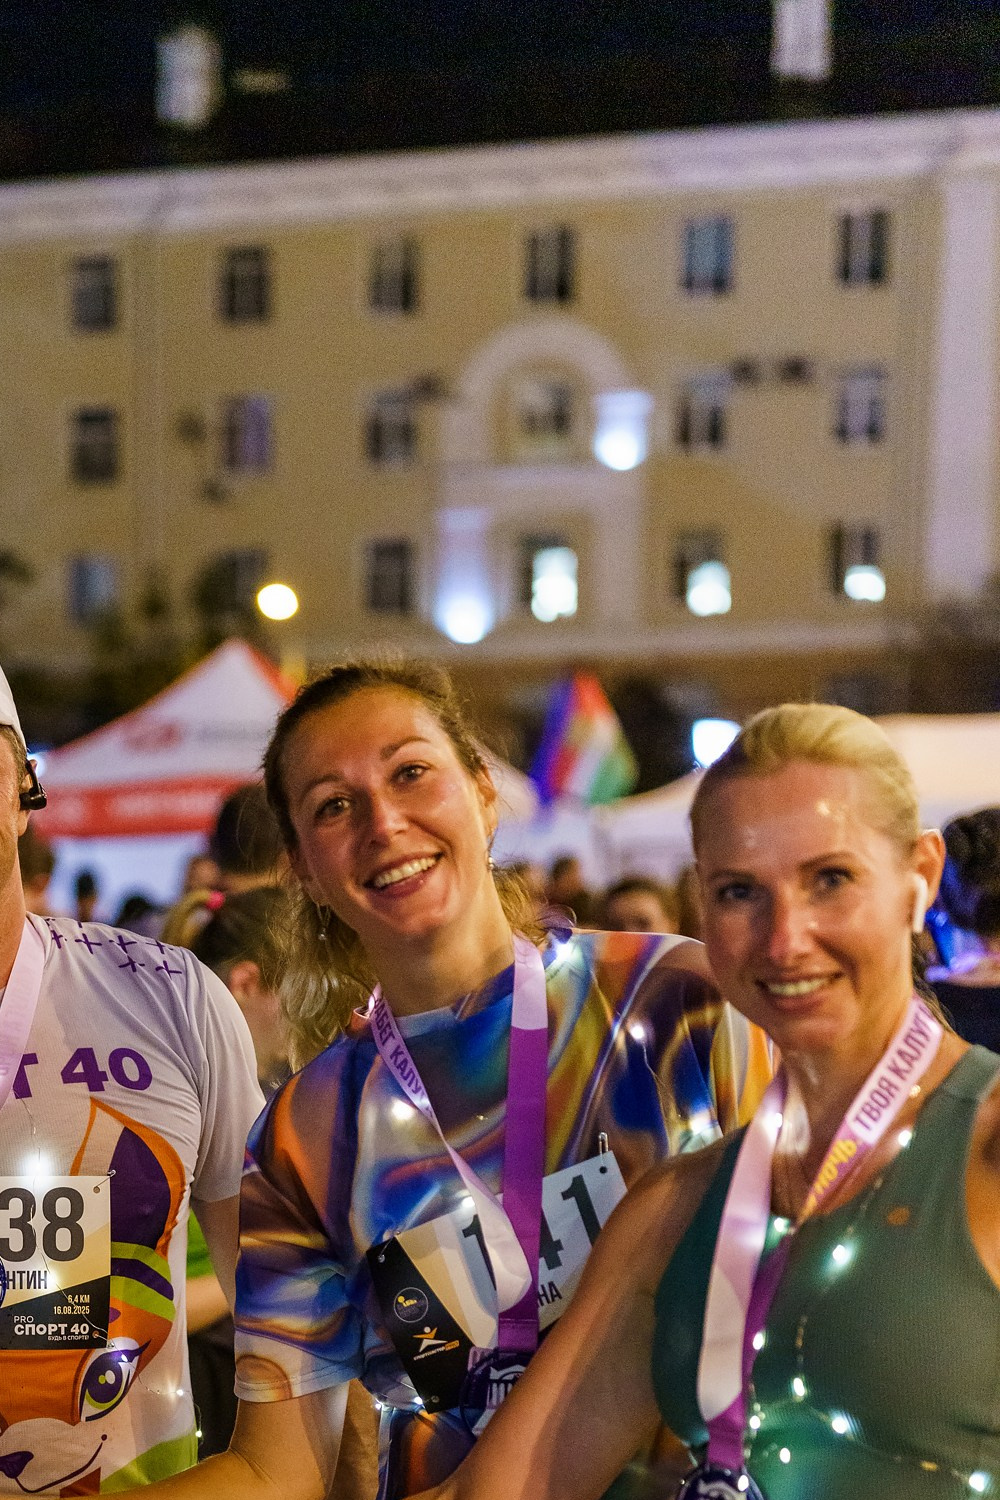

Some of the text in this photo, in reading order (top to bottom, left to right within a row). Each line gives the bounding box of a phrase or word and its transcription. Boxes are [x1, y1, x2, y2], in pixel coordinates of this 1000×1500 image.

[375, 998, 396, 1047] АБЕГ
[60, 1047, 153, 1093] 40
[854, 1075, 901, 1132] ТВОЯ
[13, 1315, 34, 1324] PRO
[53, 1305, 90, 1315] 16.08.2025
[14, 1323, 90, 1336] СПОРТ 40
